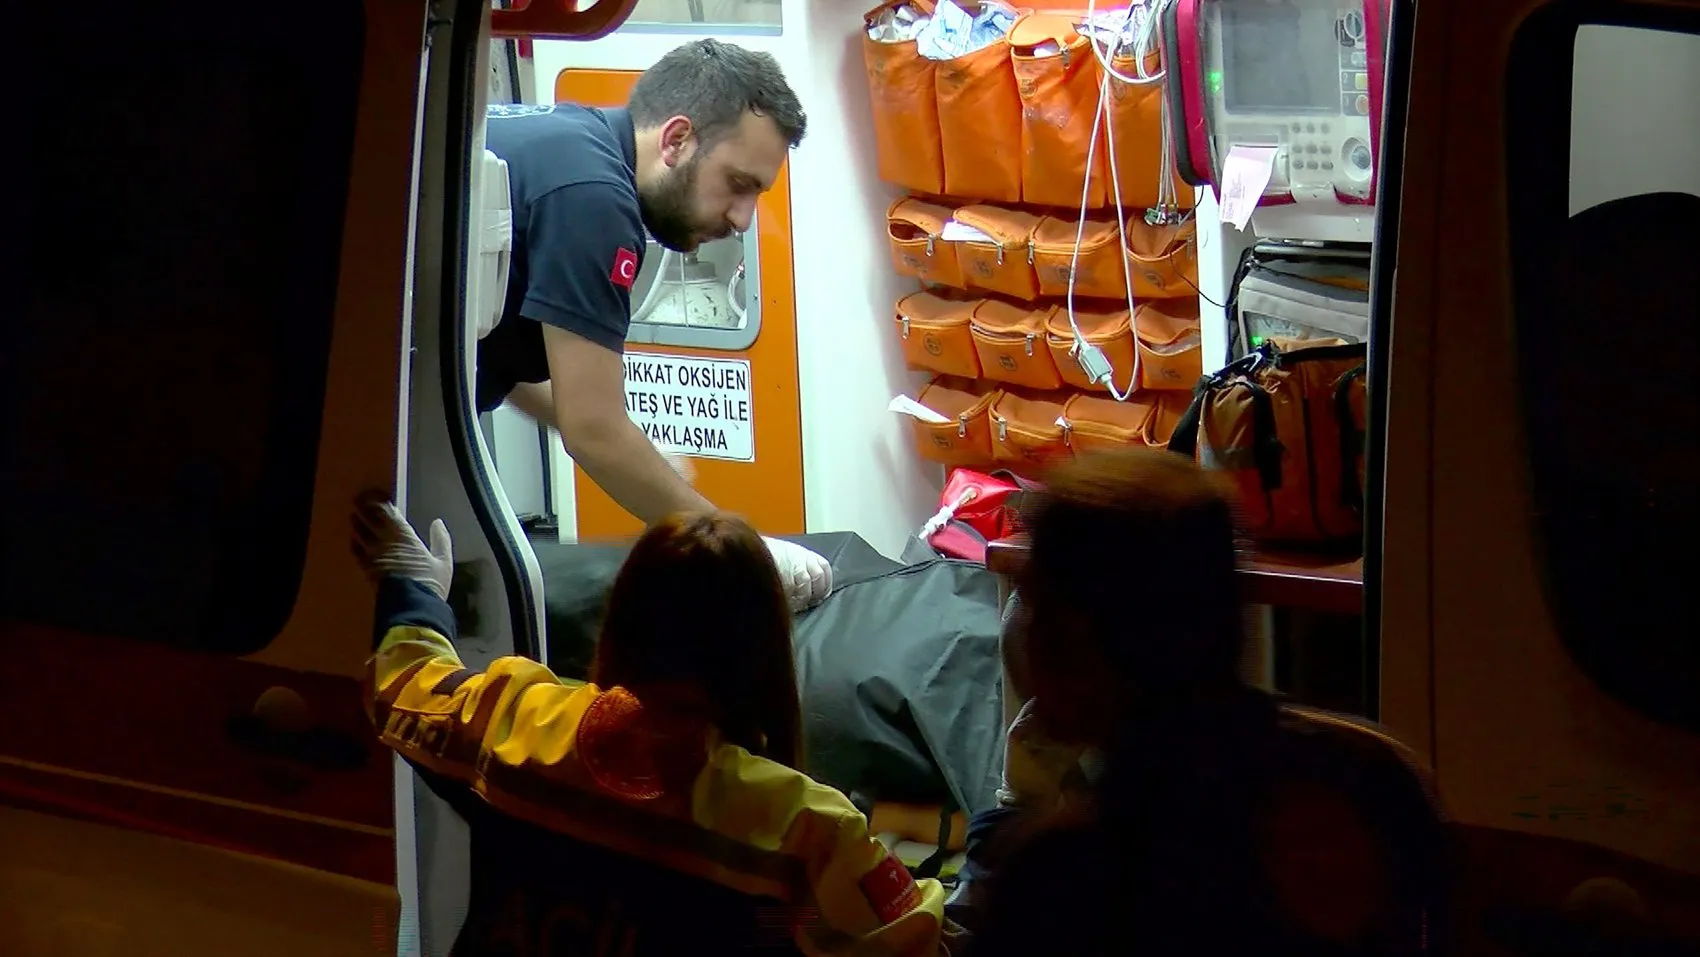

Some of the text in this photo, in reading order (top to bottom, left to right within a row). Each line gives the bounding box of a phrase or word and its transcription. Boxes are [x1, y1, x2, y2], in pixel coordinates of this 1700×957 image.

[678, 363, 746, 391] OKSİJEN
[662, 393, 683, 416] VE
[687, 392, 719, 419] YAĞ
[723, 394, 748, 421] İLE
